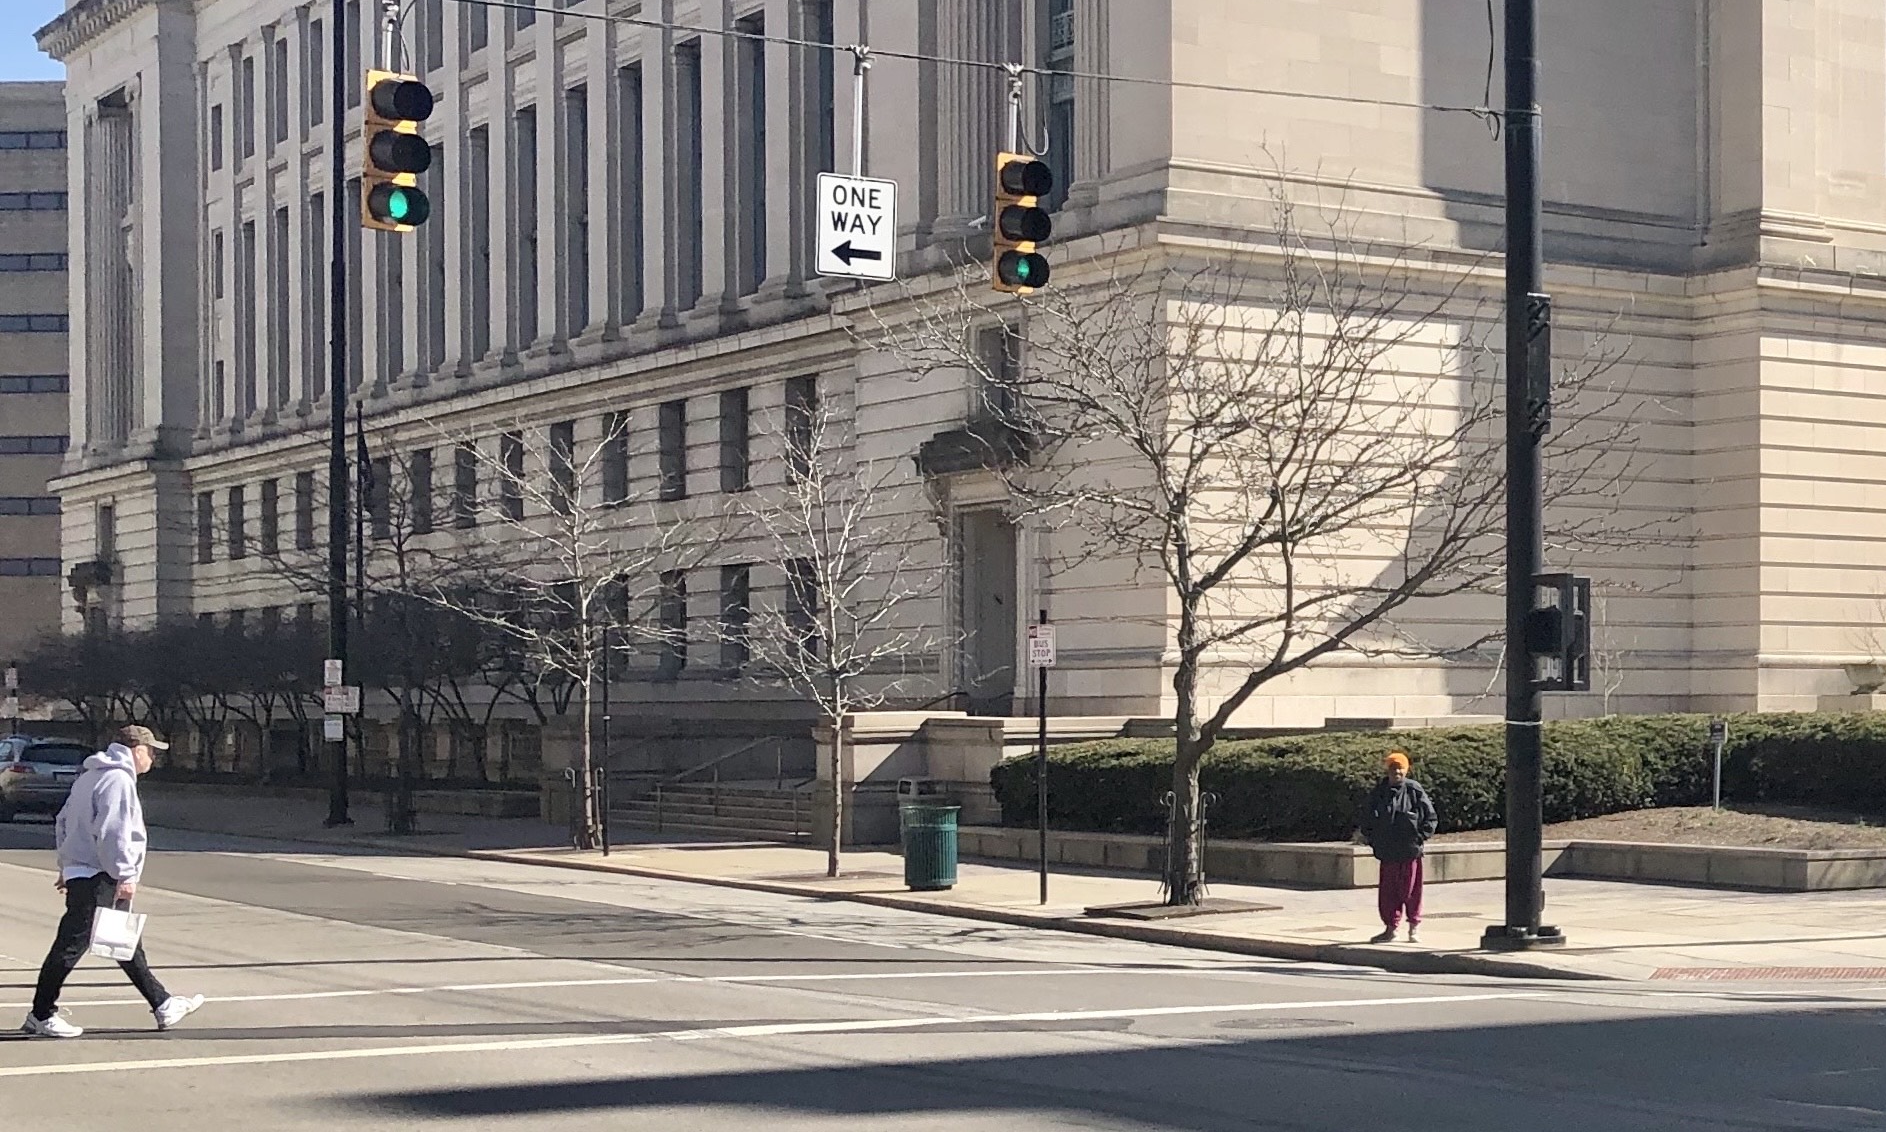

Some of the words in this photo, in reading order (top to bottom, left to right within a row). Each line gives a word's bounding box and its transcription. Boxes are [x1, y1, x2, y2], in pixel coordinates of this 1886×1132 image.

[833, 185, 882, 210] ONE
[831, 211, 883, 236] WAY
[1034, 640, 1049, 648] BUS
[1032, 649, 1051, 657] STOP
